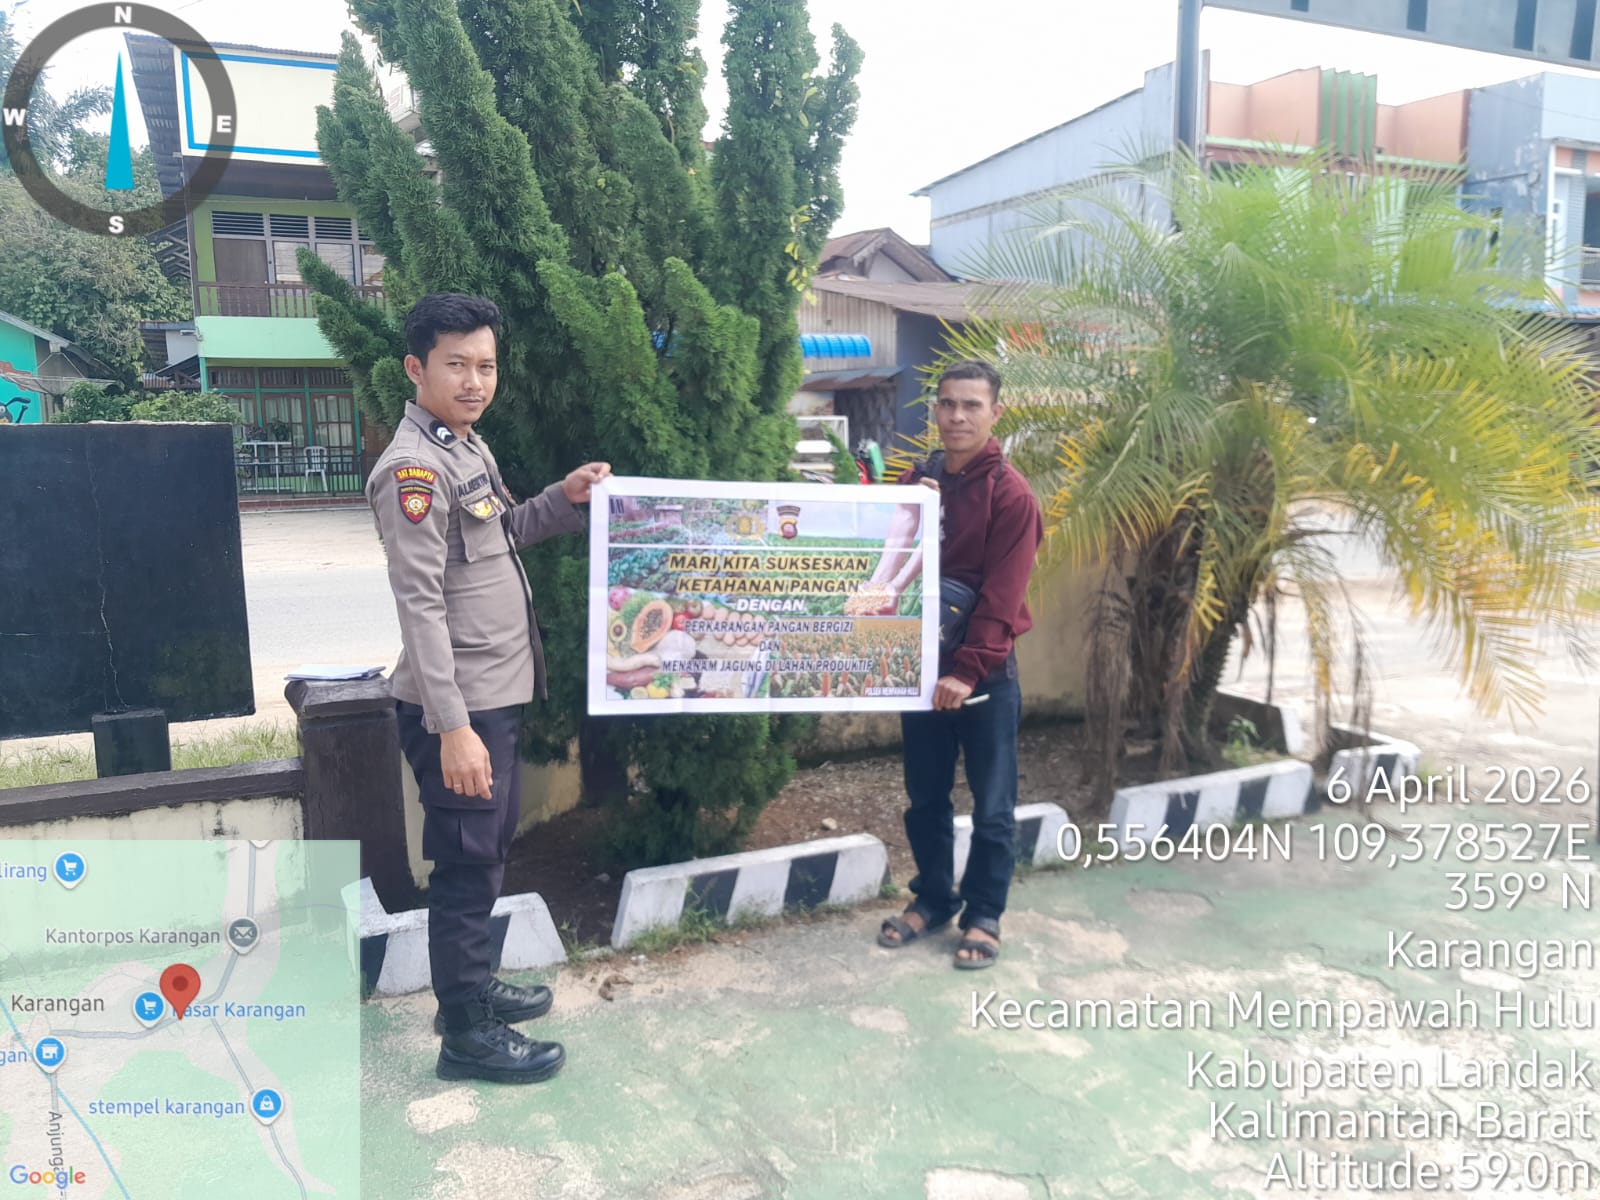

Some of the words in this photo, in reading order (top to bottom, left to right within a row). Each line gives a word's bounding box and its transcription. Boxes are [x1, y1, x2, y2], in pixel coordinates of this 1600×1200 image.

[669, 555, 718, 570] MARI
[722, 556, 761, 571] KITA
[765, 556, 869, 572] SUKSESKAN
[677, 577, 786, 593] KETAHANAN
[789, 578, 861, 594] PANGAN
[735, 598, 805, 612] DENGAN
[767, 620, 810, 633] PANGAN
[812, 621, 854, 633] BERGIZI
[759, 640, 780, 652] DAN
[662, 659, 717, 672] MENANAM
[719, 659, 763, 672] JAGUNG
[764, 659, 775, 672] DI
[778, 660, 813, 672] LAHAN
[815, 660, 874, 673] PRODUKTIF
